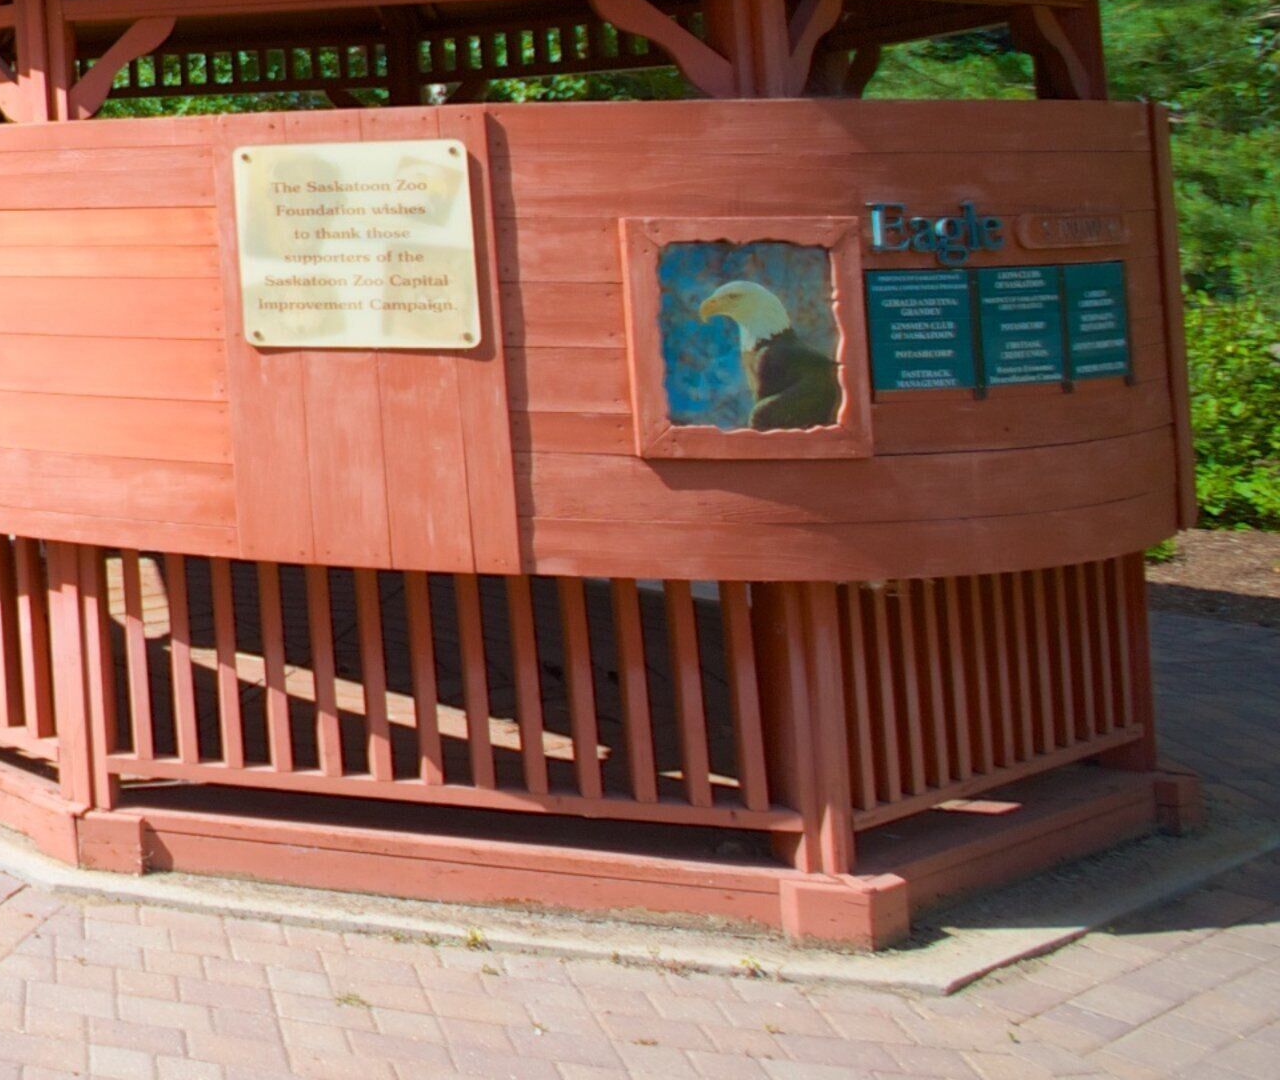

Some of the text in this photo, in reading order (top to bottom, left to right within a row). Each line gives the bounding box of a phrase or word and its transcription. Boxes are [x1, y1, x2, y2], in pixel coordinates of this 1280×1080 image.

[272, 179, 428, 194] The Saskatoon Zoo
[276, 203, 427, 217] Foundation wishes
[294, 227, 411, 240] to thank those
[865, 200, 1005, 266] Eagle
[283, 250, 425, 266] supporters of the
[264, 274, 449, 288] Saskatoon Zoo Capital
[258, 298, 458, 313] Improvement Campaign.
